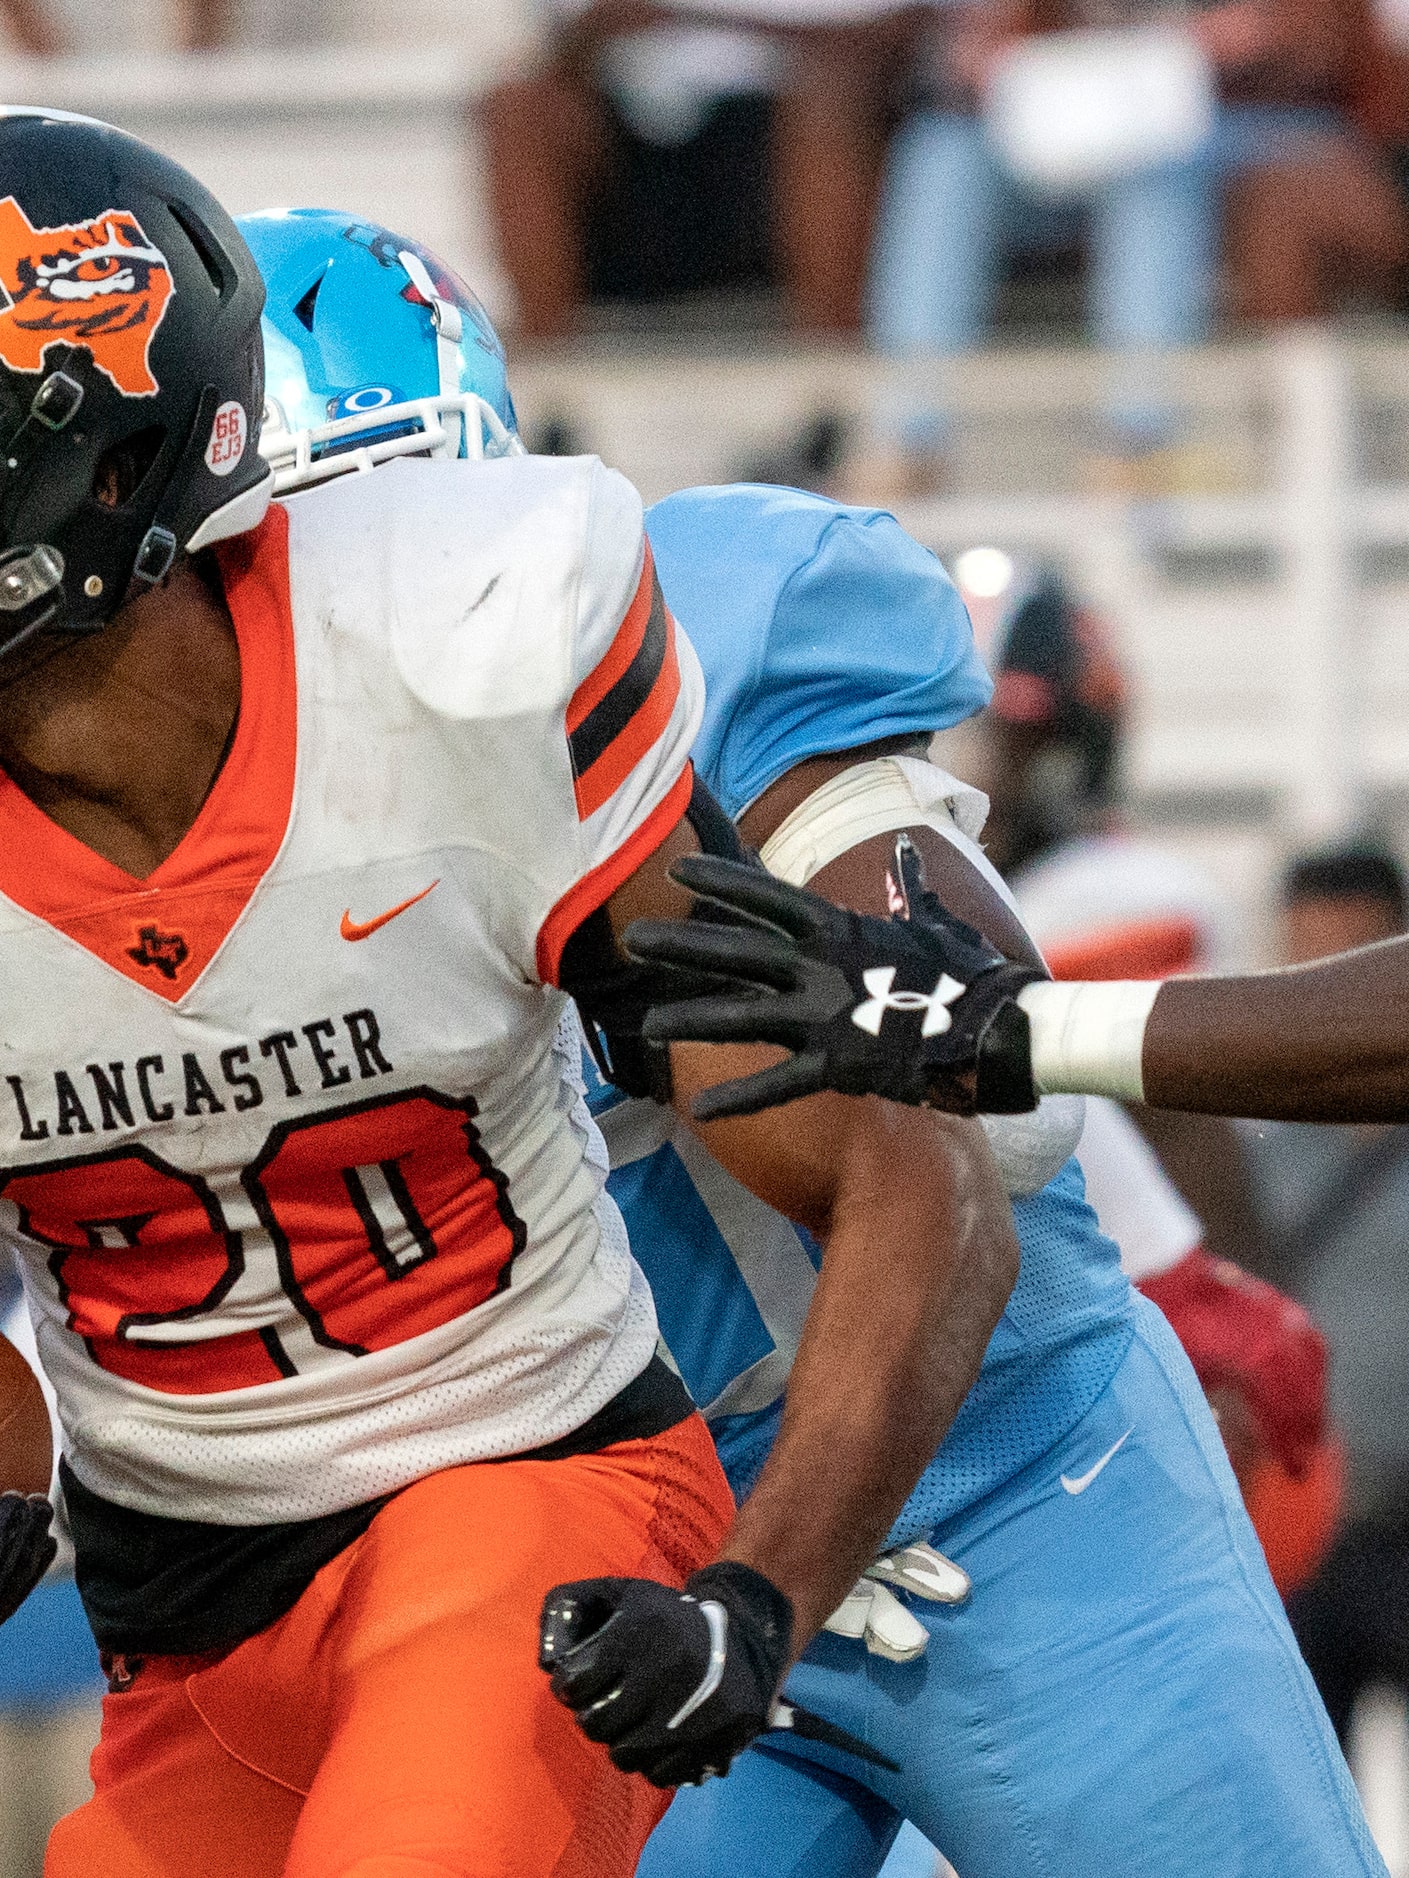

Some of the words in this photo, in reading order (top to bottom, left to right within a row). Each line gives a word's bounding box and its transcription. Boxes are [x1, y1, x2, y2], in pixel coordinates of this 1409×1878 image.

[216, 408, 239, 440] 66
[211, 434, 241, 464] EJ3
[5, 1008, 394, 1141] LANCASTER
